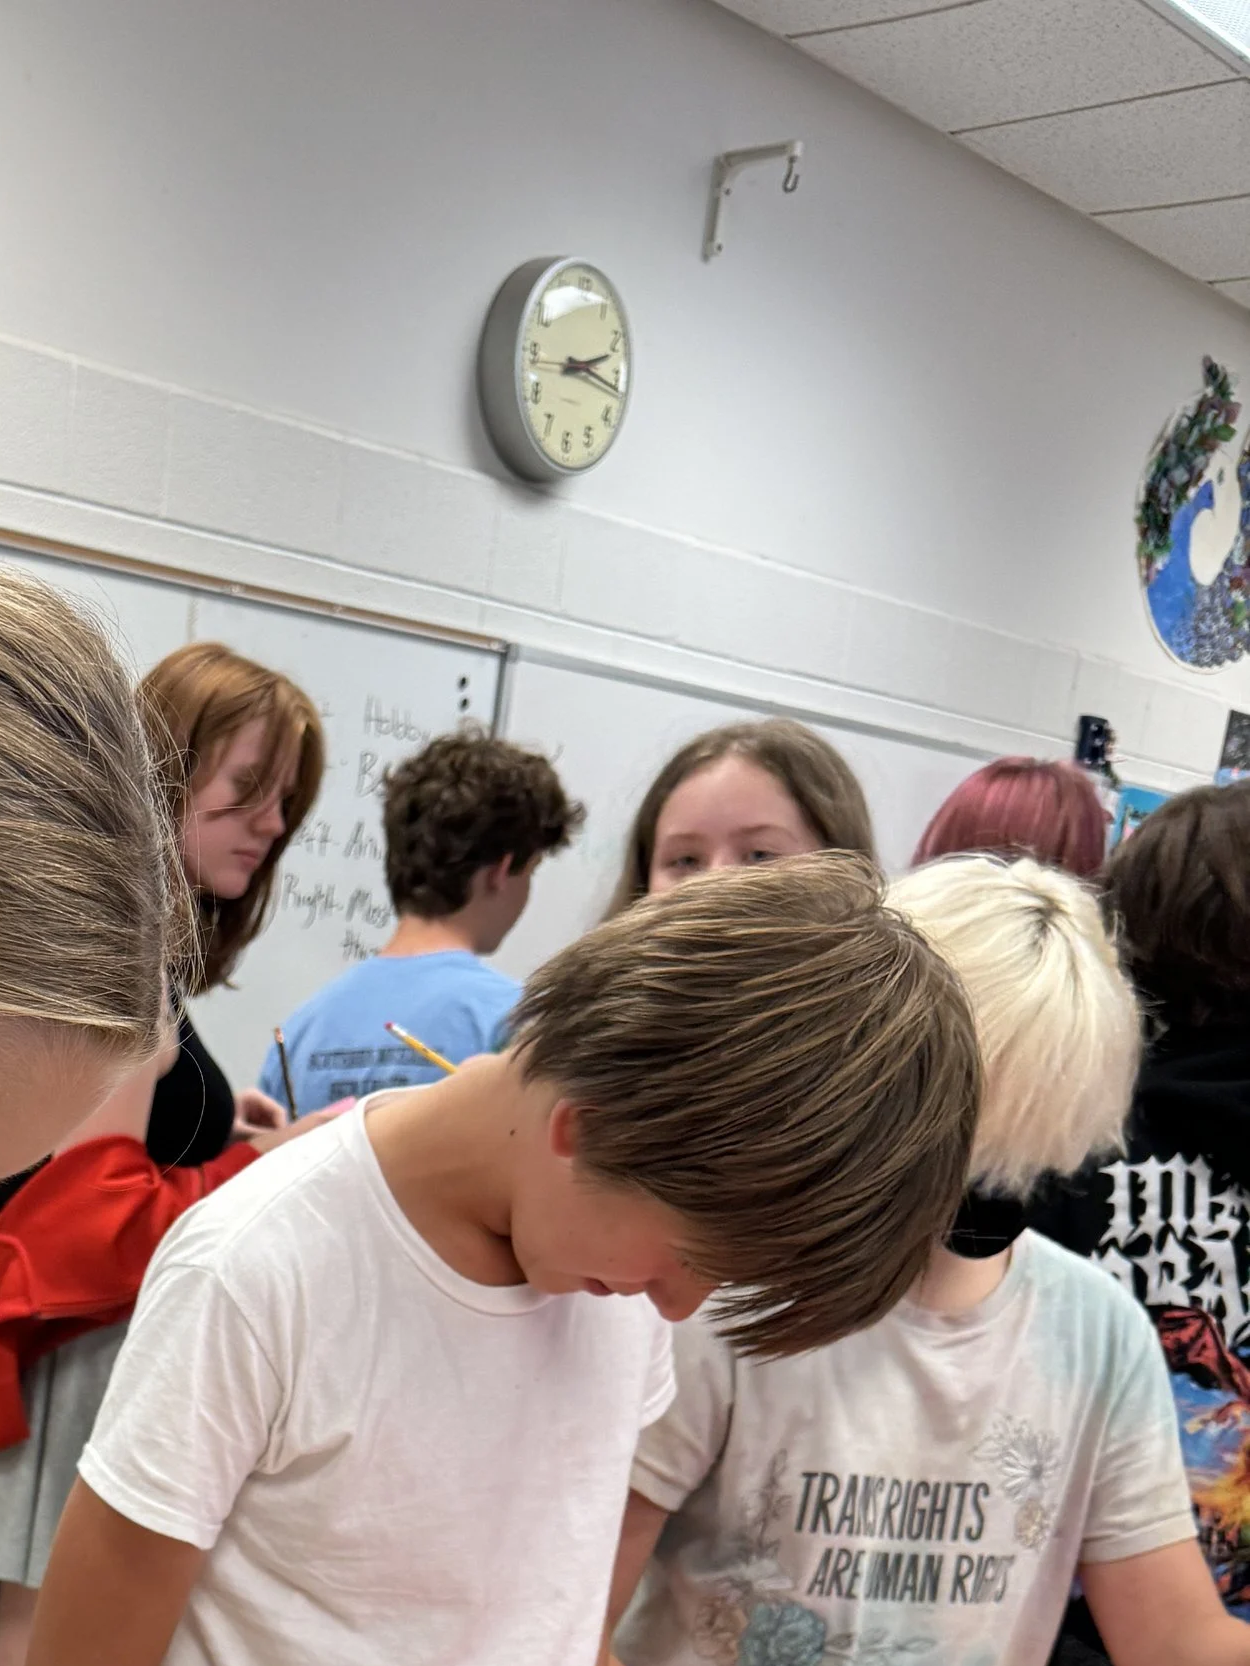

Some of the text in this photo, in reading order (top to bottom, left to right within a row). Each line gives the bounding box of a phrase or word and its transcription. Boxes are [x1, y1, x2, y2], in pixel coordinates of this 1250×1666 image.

[879, 1478, 990, 1542] RIGHTS
[806, 1547, 866, 1599] ARE
[865, 1552, 944, 1604] MAN
